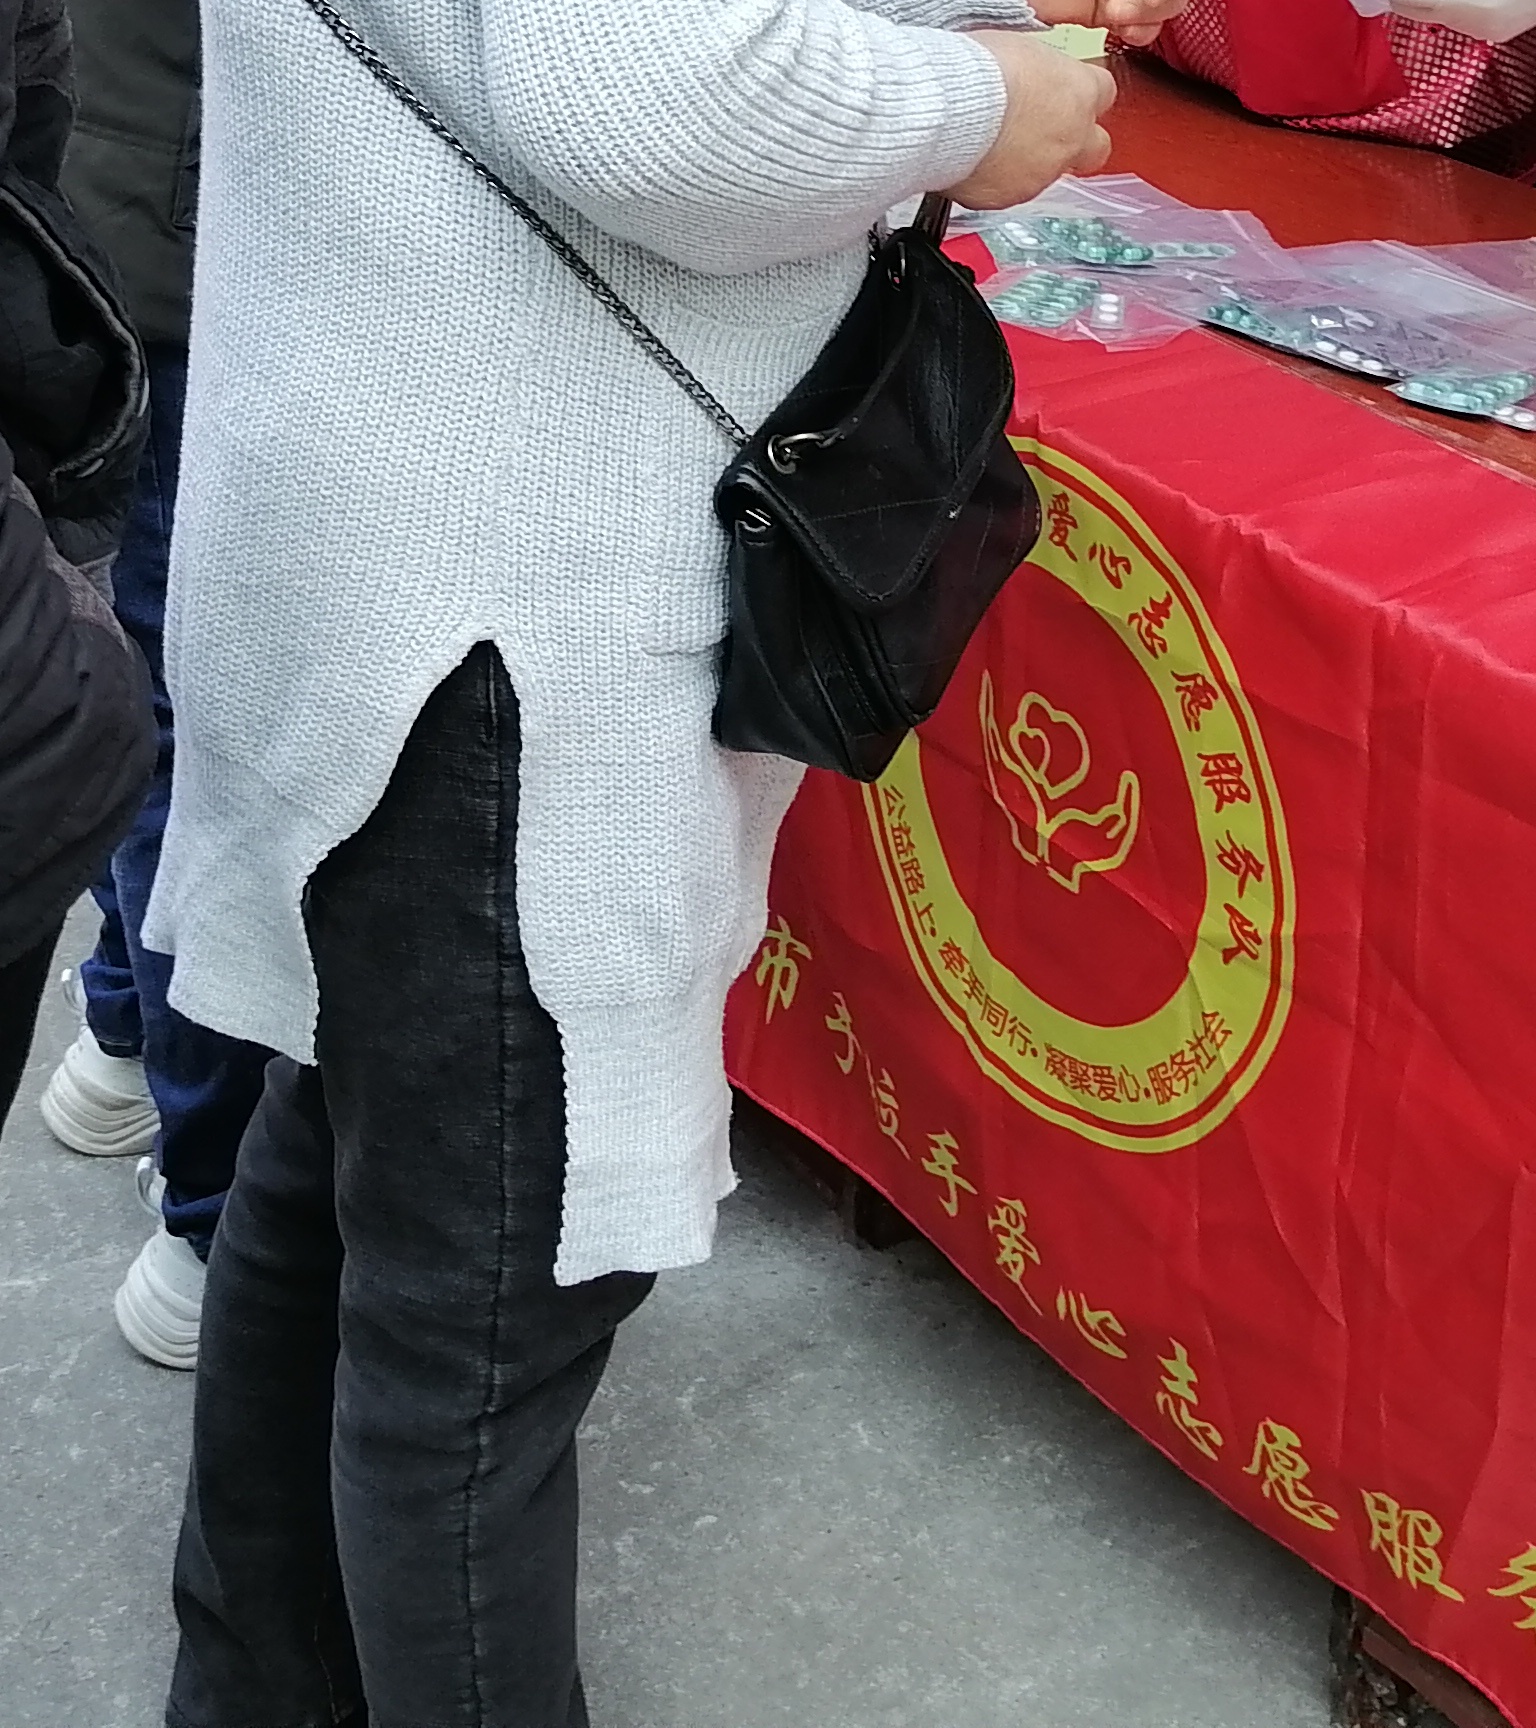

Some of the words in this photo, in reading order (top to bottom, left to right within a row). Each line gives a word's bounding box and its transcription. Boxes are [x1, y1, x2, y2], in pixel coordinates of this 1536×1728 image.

[1044, 489, 1266, 967] 爱心志愿服务队
